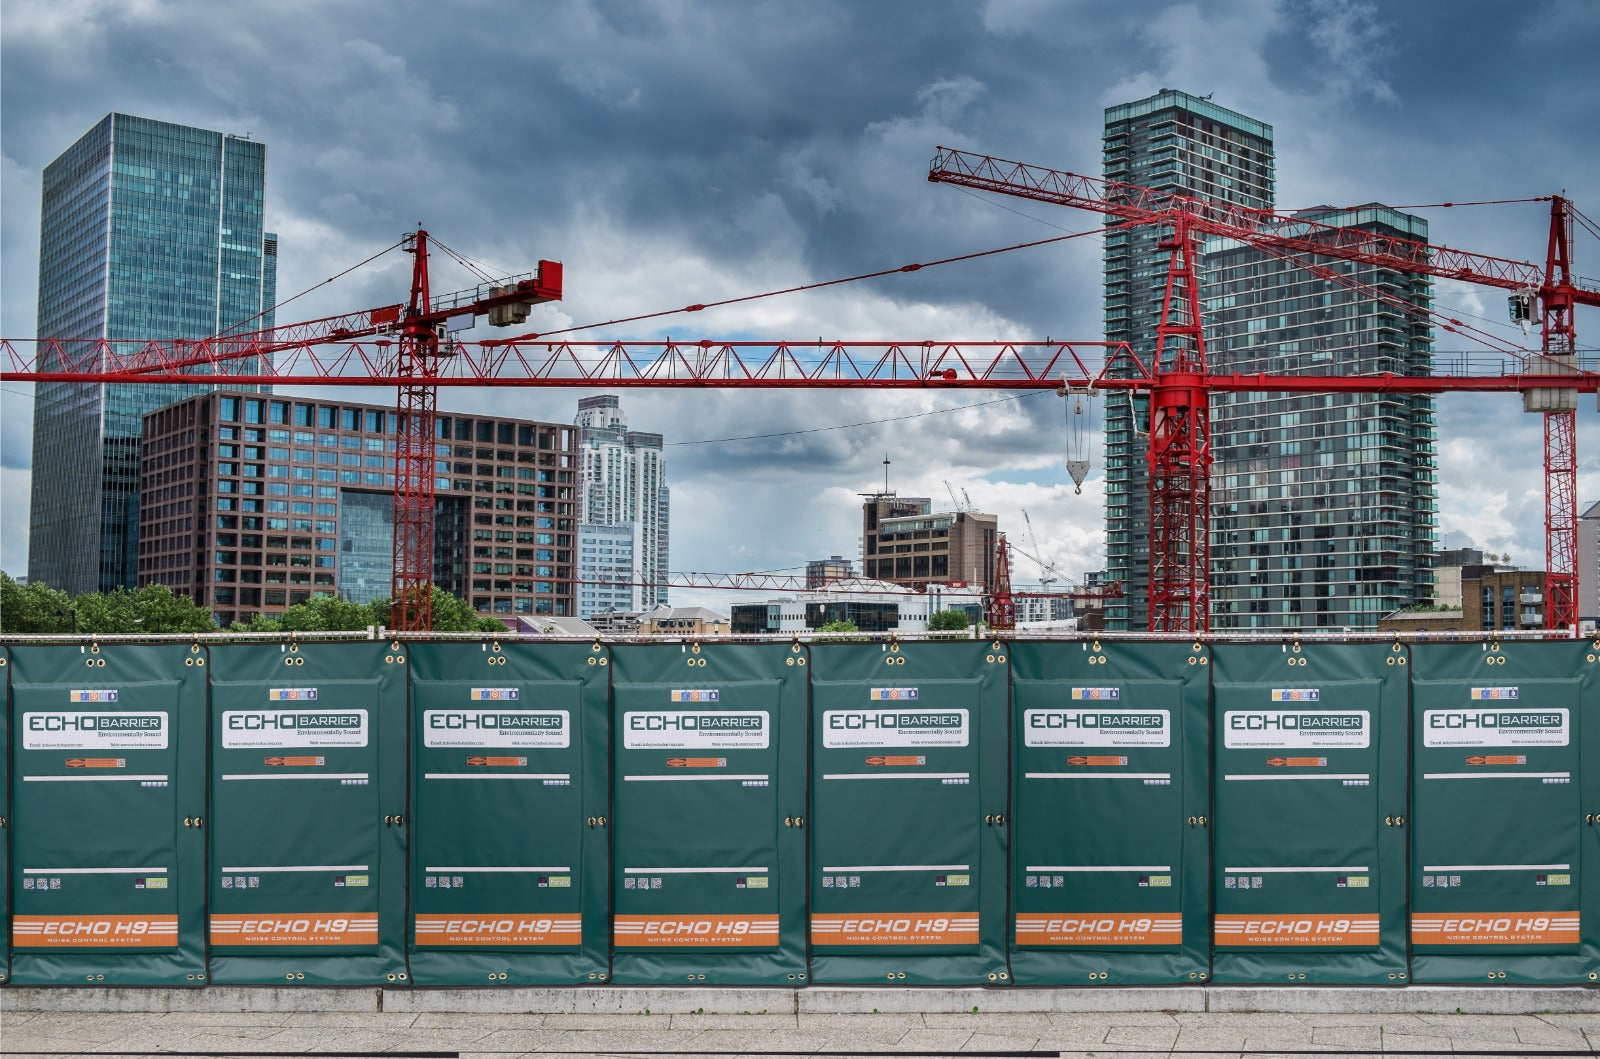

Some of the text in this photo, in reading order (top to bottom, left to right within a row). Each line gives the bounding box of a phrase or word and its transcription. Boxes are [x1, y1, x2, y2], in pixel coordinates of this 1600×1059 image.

[30, 716, 159, 731] ECHO BARRIER
[229, 714, 358, 730] ECHO BARRIER
[430, 714, 560, 729] ECHO BARRIER
[631, 716, 759, 730] ECHO BARRIER
[830, 714, 959, 729] ECHO BARRIER
[1031, 714, 1160, 729] ECHO BARRIER
[1231, 715, 1360, 730] ECHO BARRIER
[1430, 714, 1560, 729] ECHO BARRIER
[43, 921, 149, 935] ECHO H9
[241, 919, 348, 933] ECHO H9
[445, 919, 552, 933] ECHO H9
[644, 921, 750, 934] ECHO H9
[843, 918, 949, 933] ECHO H9
[1046, 918, 1152, 933] ECHO H9
[1244, 920, 1350, 934] ECHO H9
[1443, 918, 1550, 932] ECHO H9
